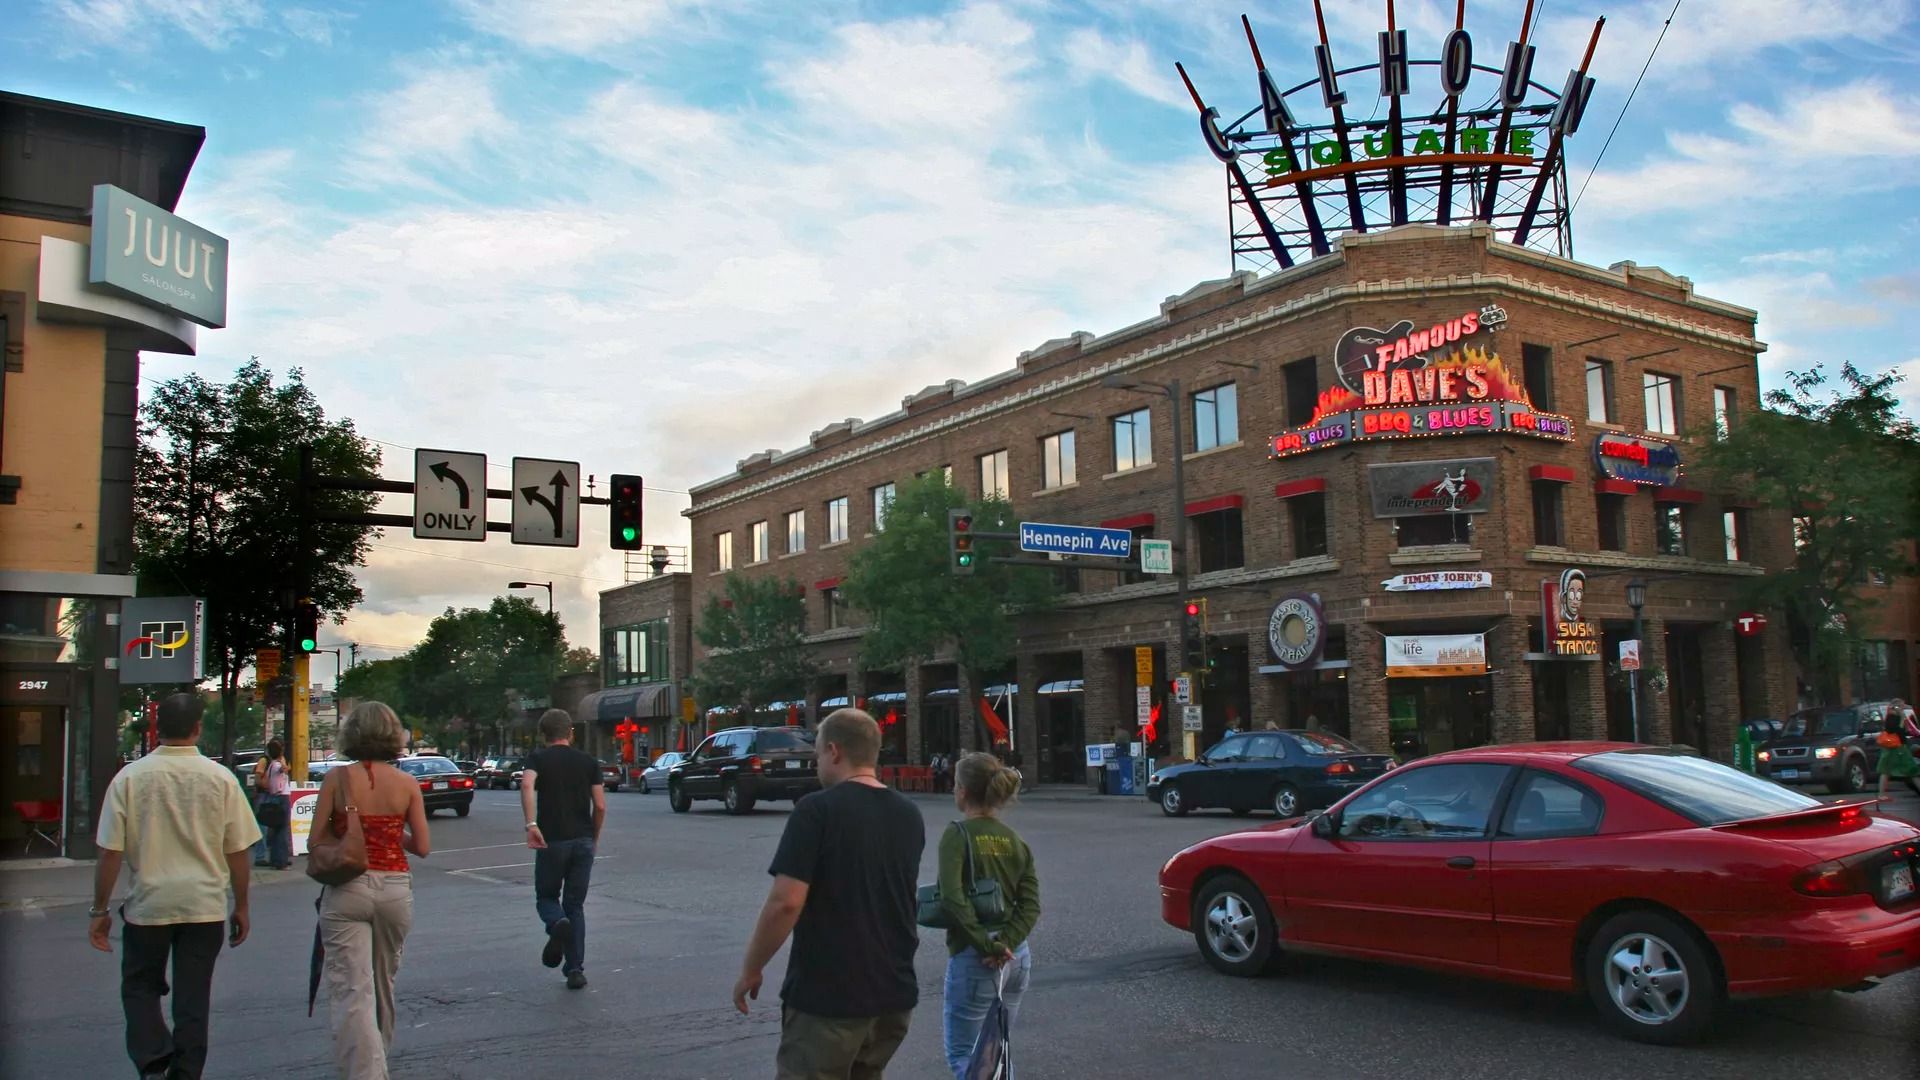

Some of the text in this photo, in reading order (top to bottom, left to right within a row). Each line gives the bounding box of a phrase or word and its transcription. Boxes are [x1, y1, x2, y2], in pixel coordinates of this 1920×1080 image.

[1200, 29, 1596, 163] CALHOUN
[1263, 128, 1535, 176] SQUARE
[123, 207, 216, 292] JUUT
[1376, 311, 1480, 372] FAMOUS
[1363, 365, 1489, 405] DAVE'S
[1363, 407, 1495, 434] BBQ & BLUES
[1512, 413, 1536, 430] BBQ
[1540, 418, 1568, 435] BLUES
[1276, 433, 1302, 451] BBQ
[1309, 424, 1344, 445] BLUES
[423, 512, 477, 531] ONLY
[1023, 529, 1129, 551] Hennepin Ave
[1402, 572, 1483, 584] JIMMY JOHN'S
[1403, 643, 1423, 655] life
[19, 681, 48, 690] 2947
